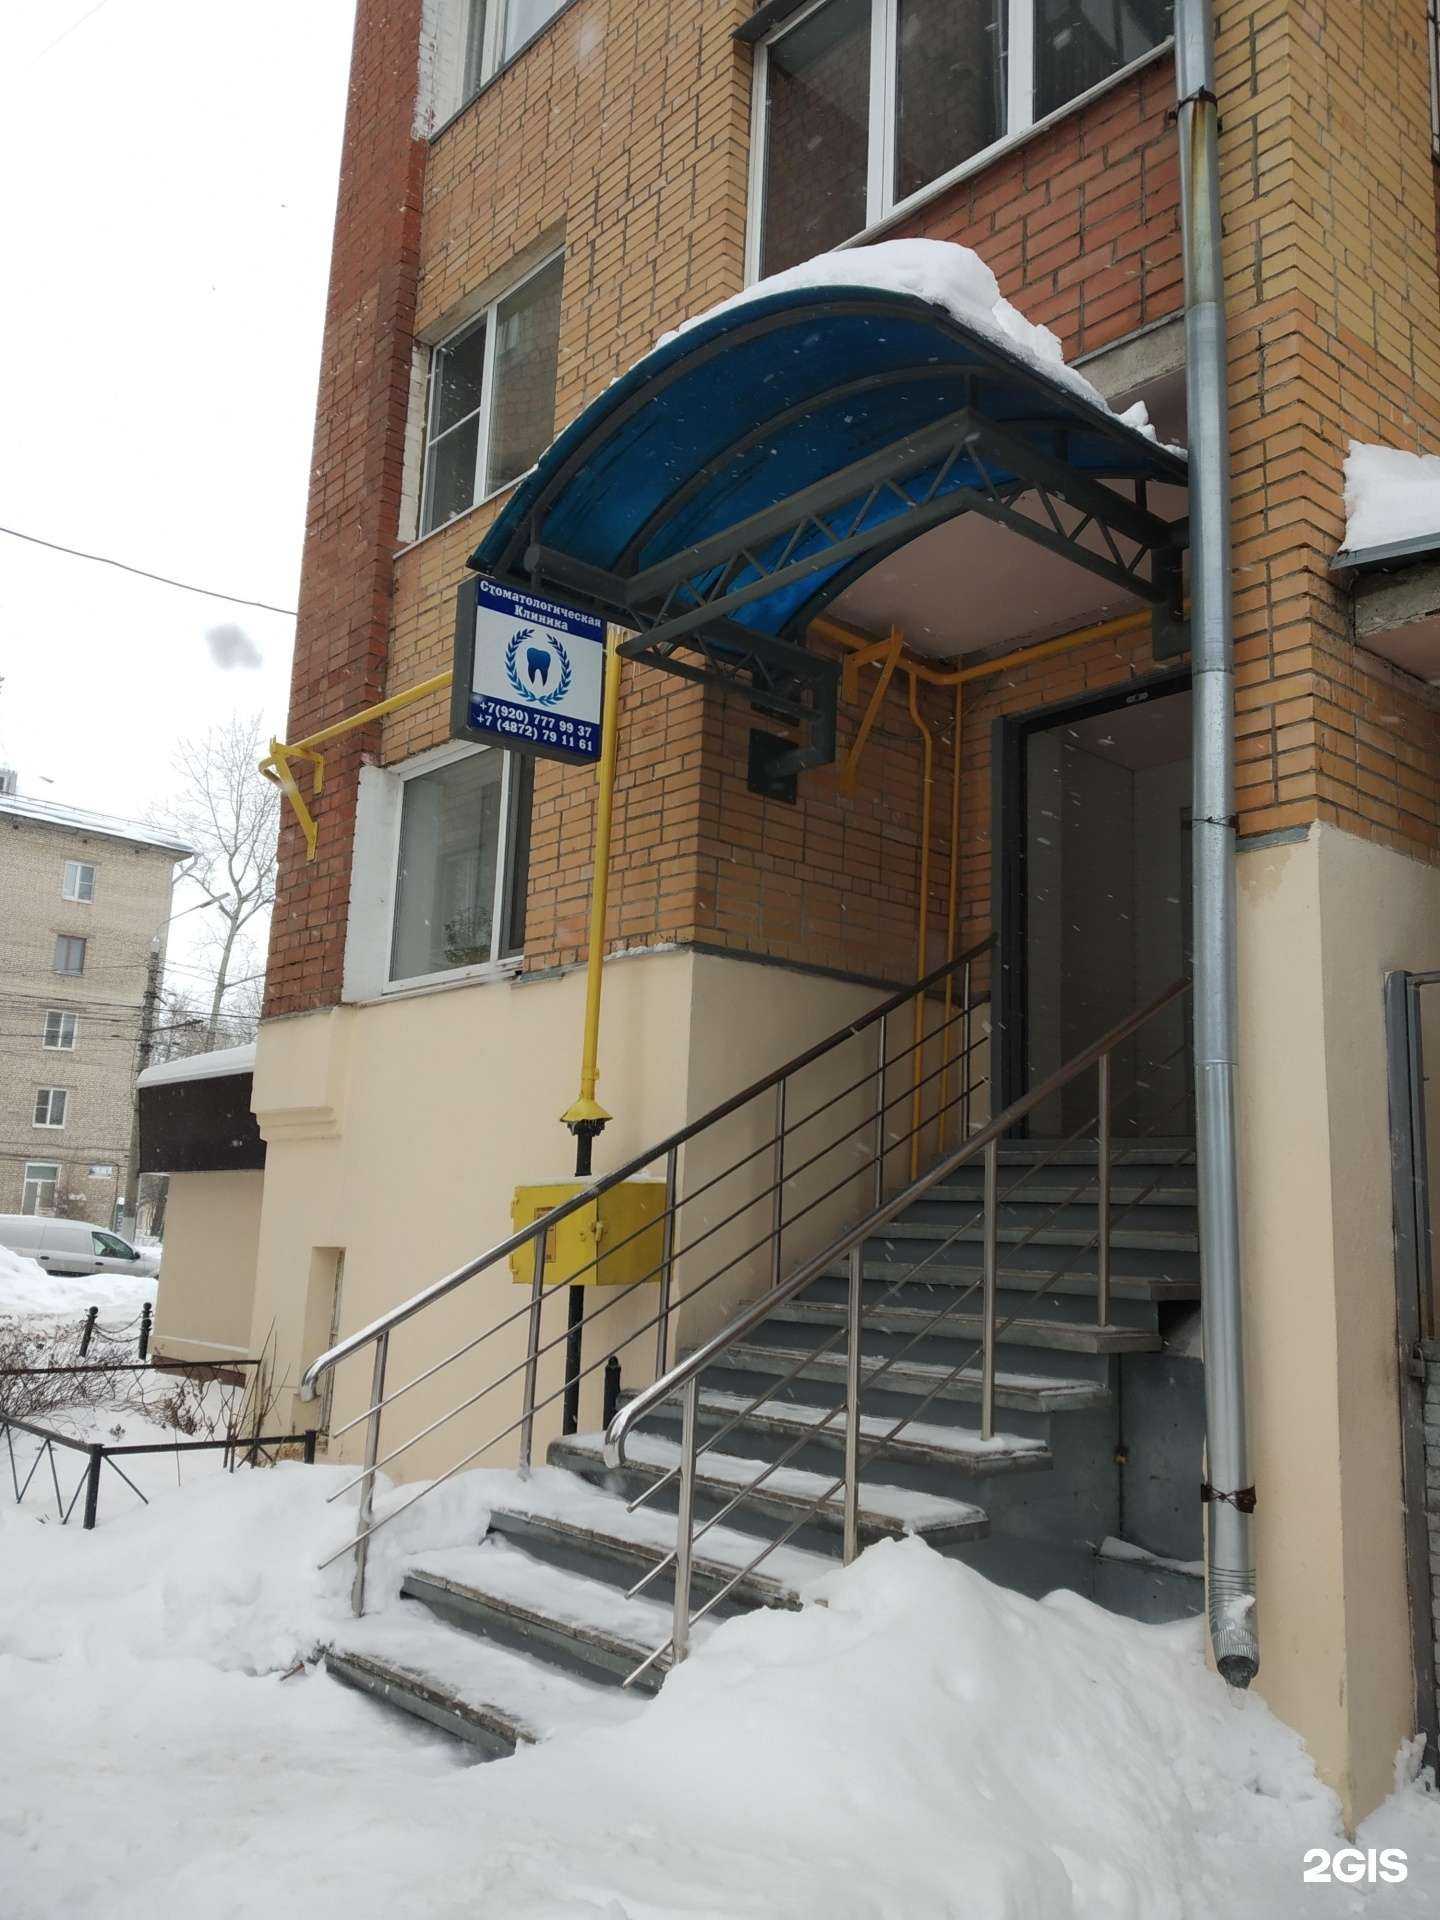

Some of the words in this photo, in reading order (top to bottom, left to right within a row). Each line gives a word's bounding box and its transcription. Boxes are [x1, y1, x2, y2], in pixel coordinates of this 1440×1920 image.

[480, 580, 601, 628] Стоматологическая
[514, 604, 569, 631] Клиника
[477, 714, 492, 726] +7
[497, 718, 538, 741] (4872)
[542, 730, 557, 743] 79
[561, 735, 575, 747] 11
[579, 738, 593, 752] 61
[533, 714, 555, 729] 777
[559, 721, 574, 734] 99
[577, 725, 592, 738] 37
